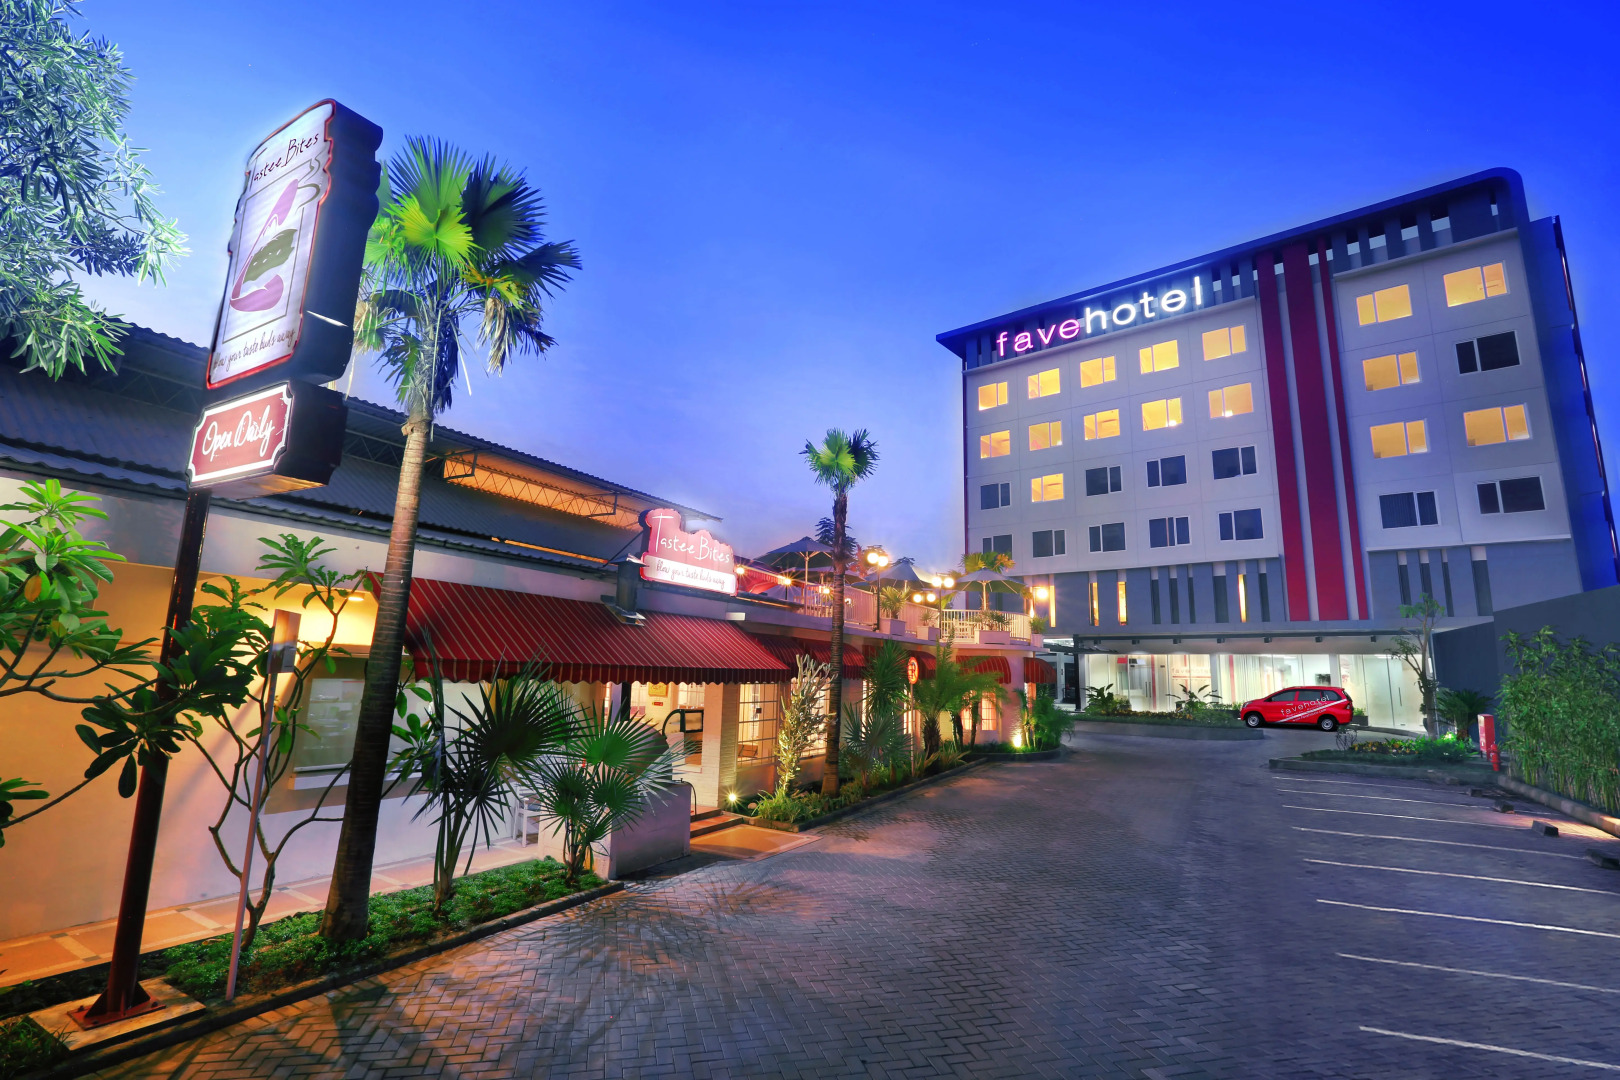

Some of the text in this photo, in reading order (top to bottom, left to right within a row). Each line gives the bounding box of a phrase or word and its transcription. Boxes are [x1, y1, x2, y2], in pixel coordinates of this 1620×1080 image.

[249, 131, 319, 192] Tastee Bites
[996, 276, 1202, 357] favehotel
[243, 339, 259, 357] taste
[202, 405, 275, 462] Open Daily
[652, 512, 730, 563] Tastee Bites
[1281, 695, 1330, 716] favehotel
